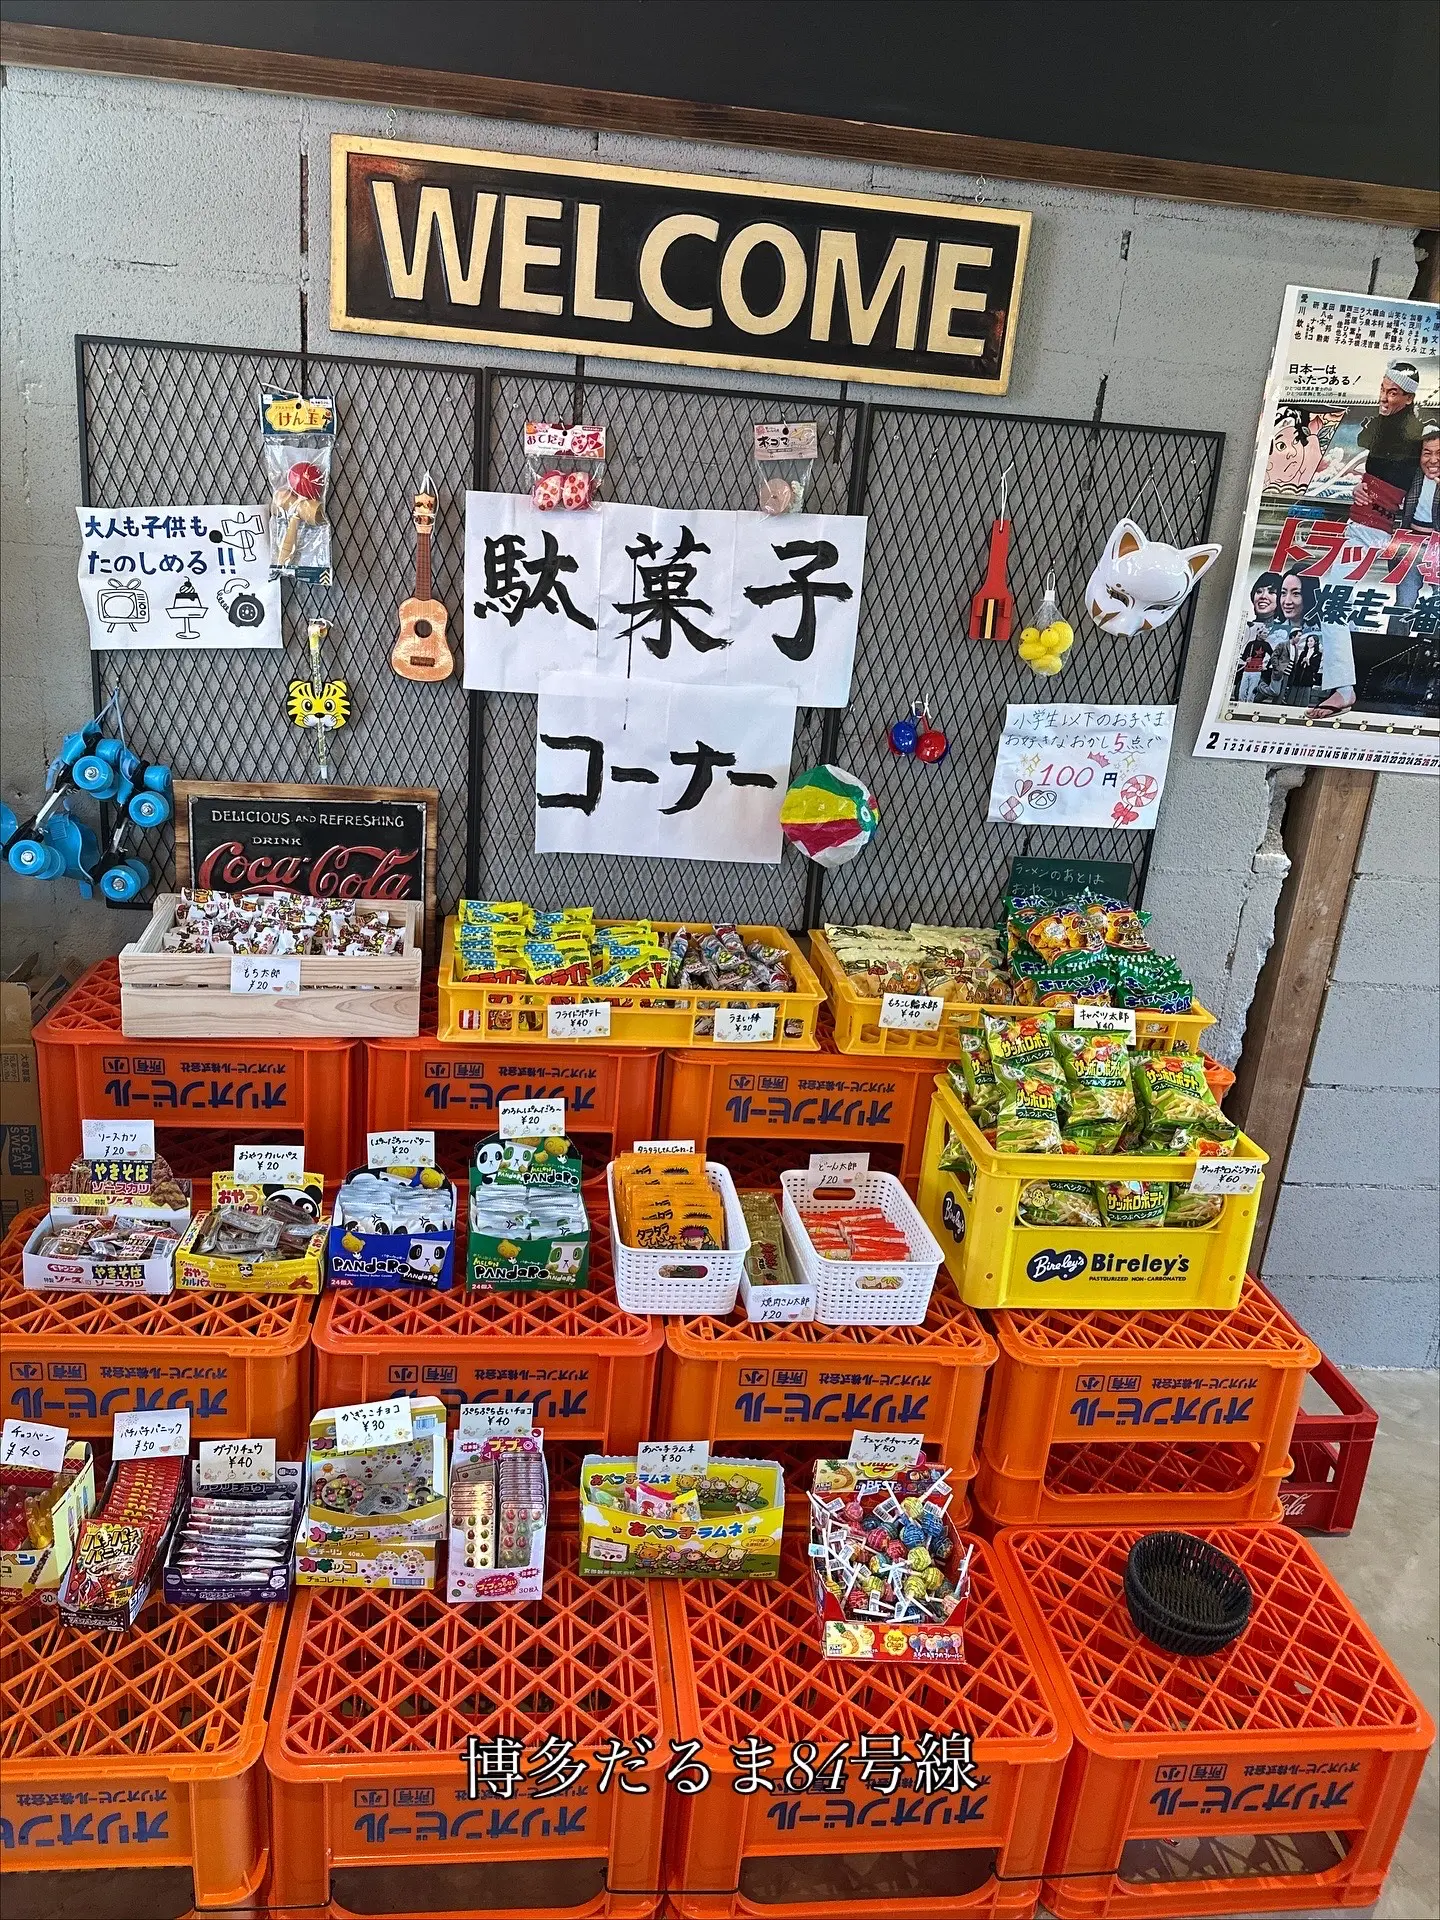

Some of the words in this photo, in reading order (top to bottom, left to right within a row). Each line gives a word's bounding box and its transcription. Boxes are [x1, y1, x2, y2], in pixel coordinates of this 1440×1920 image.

[370, 179, 993, 358] WELCOME
[1289, 363, 1337, 375] 日本一は
[278, 411, 320, 427] けん玉
[84, 515, 208, 540] 大人も子供も
[472, 524, 854, 661] 駄菓子
[1013, 708, 1166, 731] 小学生以下のお子さま
[1004, 732, 1163, 752] お好きなおかし5点で
[1206, 731, 1220, 750] 2
[1223, 742, 1228, 750] 1
[1230, 742, 1237, 751] 2
[1238, 743, 1244, 752] 3
[1246, 744, 1252, 752] 4
[1254, 744, 1260, 752] 5
[1261, 745, 1268, 753] 6
[1269, 746, 1276, 754] 7
[1276, 746, 1283, 754] 8
[1284, 747, 1290, 755] 9
[1292, 748, 1299, 756] 10
[1300, 748, 1307, 756] 11
[1308, 749, 1316, 757] 12
[536, 733, 778, 816] コーナー
[211, 809, 291, 825] DELICIOUS
[295, 814, 317, 824] AND
[319, 813, 405, 828] REFRESHING
[252, 836, 302, 846] DRINK
[198, 841, 420, 899] Coca-Cola
[1015, 862, 1105, 885] ラーメンのあとは
[243, 968, 281, 979] もち太郎
[247, 980, 269, 992] ¥20
[1038, 974, 1096, 991] キャベツ
[887, 999, 939, 1011] もろこし輪太郎
[1124, 990, 1180, 1007] キャベツ
[554, 1008, 602, 1020] フライドポテト
[728, 1012, 762, 1024] うまい棒
[900, 1010, 921, 1018] ¥40
[1079, 1009, 1131, 1022] キャベツ太郎
[570, 1019, 589, 1028] ¥40
[735, 1024, 753, 1032] ¥20
[1146, 1068, 1200, 1091] サッポロポテト
[104, 1078, 287, 1109] オリオンビール
[725, 1095, 893, 1127] オリオンビール
[521, 1115, 541, 1125] ¥20
[9, 1126, 23, 1170] SWEAT
[19, 1126, 33, 1174] POCARI
[104, 1145, 125, 1157] ¥20
[238, 1150, 299, 1161] おやつカルパス
[391, 1146, 410, 1155] ¥20
[94, 1162, 149, 1182] やきそば
[257, 1160, 280, 1171] ¥20
[1199, 1164, 1262, 1175] サッポロベジタブル
[818, 1174, 839, 1187] ¥20
[1218, 1174, 1241, 1184] ¥60
[91, 1181, 152, 1195] ソースカツ
[56, 1195, 79, 1203] 50個入
[106, 1195, 134, 1206] ソース
[217, 1189, 259, 1205] おやつ
[1107, 1192, 1165, 1211] サッポロポテト
[636, 1222, 670, 1240] タラタラ
[1032, 1253, 1086, 1279] Bireley's
[1090, 1252, 1191, 1276] Bireley's
[54, 1275, 82, 1284] ソース
[94, 1266, 142, 1280] やきそば
[183, 1267, 210, 1278] おやつ
[95, 1279, 144, 1288] ソースカツ
[181, 1277, 212, 1288] カルパス
[760, 1296, 811, 1308] 焼肉さん太郎
[760, 1310, 782, 1321] ¥20
[734, 1391, 930, 1424] オリオンビール
[1069, 1395, 1256, 1426] オリオンビール
[362, 1420, 385, 1432] ¥30
[487, 1416, 510, 1426] ¥40
[11, 1425, 55, 1442] チョコペン
[120, 1422, 183, 1439] パチパチパニック
[5, 1441, 41, 1462] ¥40
[133, 1440, 155, 1456] ¥50
[212, 1442, 263, 1457] ガブリチュウ
[641, 1444, 696, 1454] あべっ子ラムネ
[873, 1443, 896, 1453] ¥50
[228, 1455, 253, 1469] ¥40
[661, 1454, 682, 1463] ¥30
[590, 1473, 672, 1487] あべっ子ラムネ
[627, 1521, 744, 1540] あべっ子ラムネ
[82, 1528, 142, 1552] パチパチ
[299, 1557, 358, 1574] カギッコ
[305, 1576, 349, 1584] チョコレート
[1149, 1780, 1355, 1817] オリオンビール
[767, 1795, 989, 1831] オリオンビール
[354, 1805, 588, 1843] オリオンビール
